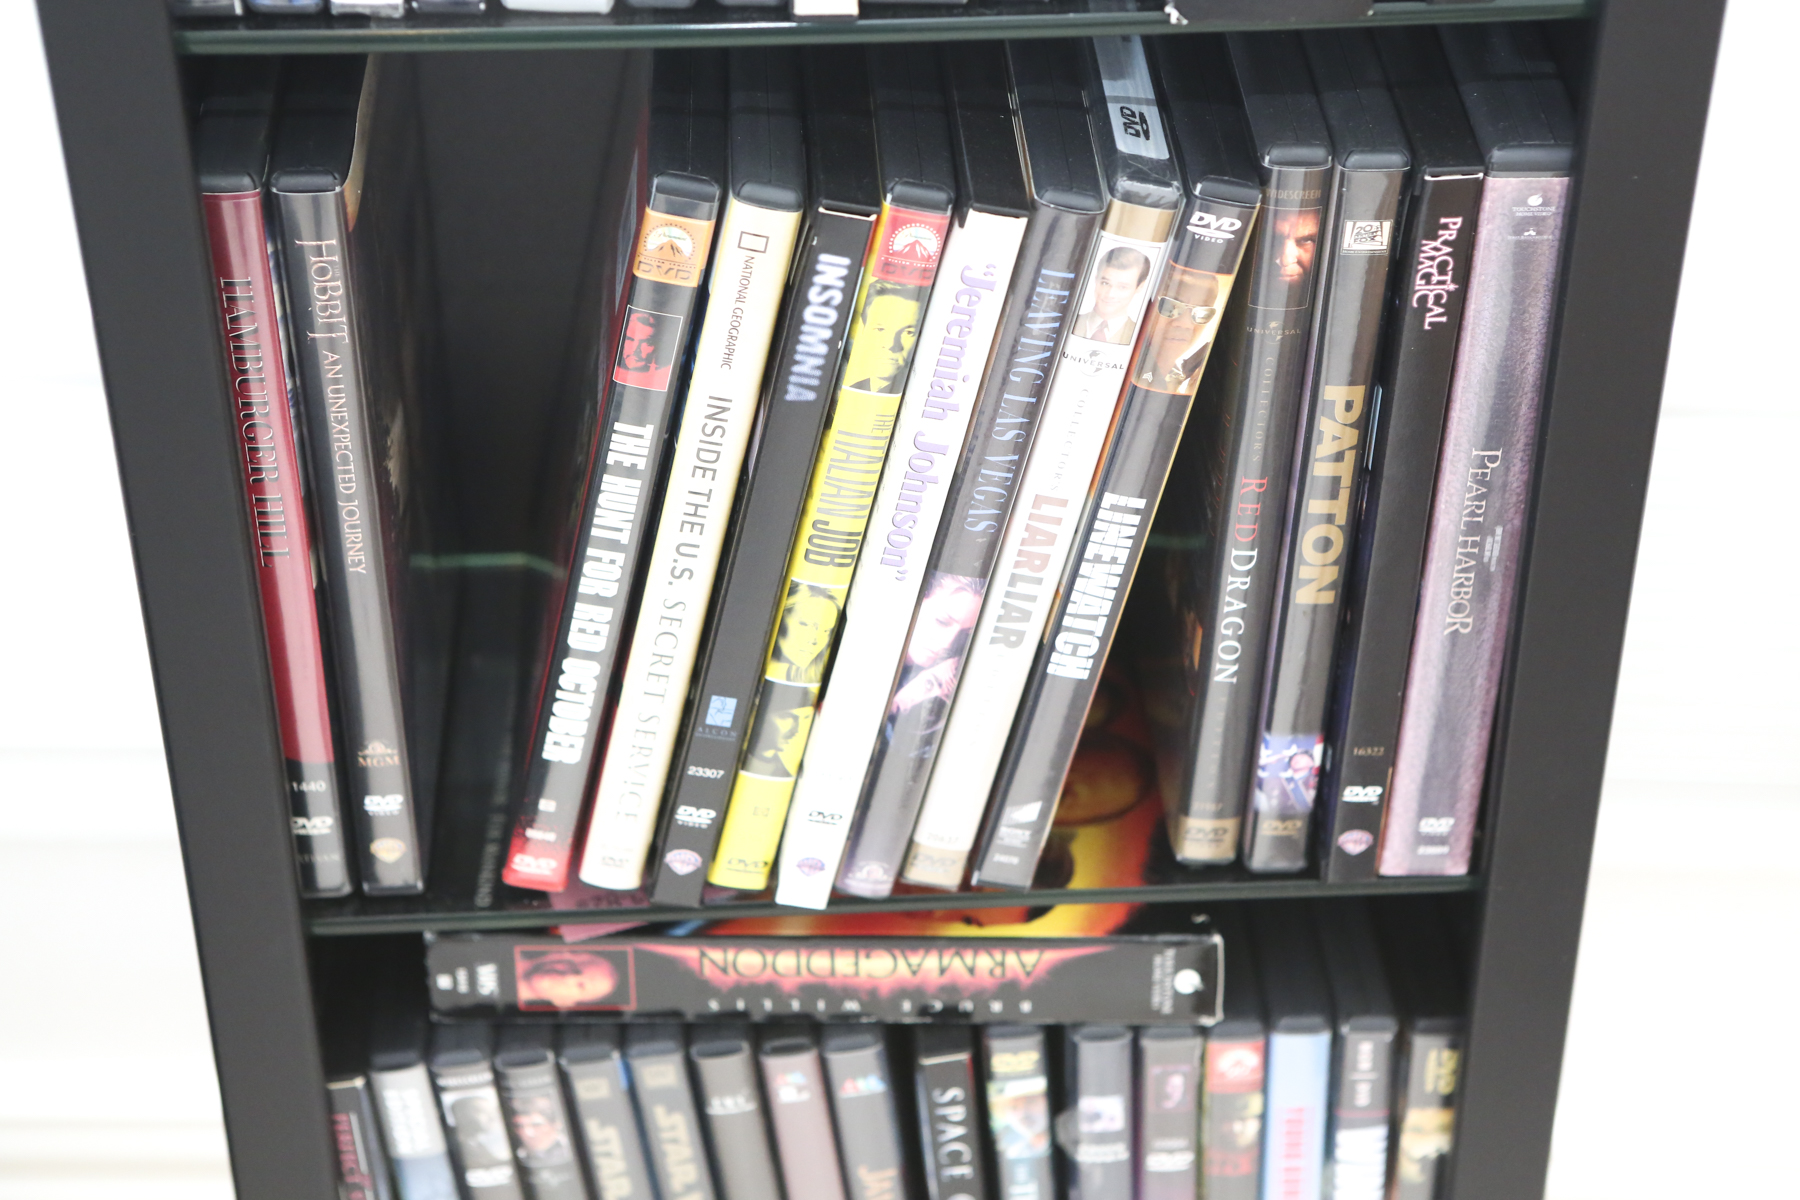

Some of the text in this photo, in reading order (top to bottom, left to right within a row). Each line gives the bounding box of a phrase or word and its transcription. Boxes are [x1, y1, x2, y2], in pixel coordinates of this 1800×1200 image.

[1119, 105, 1141, 138] DVD
[1189, 212, 1242, 232] DVD
[1267, 188, 1322, 200] WIDESCREEN
[1194, 234, 1223, 244] VIDEO
[1424, 217, 1462, 330] PRACTICAL
[720, 255, 756, 371] NATIONAL GEOGRAPHIC
[783, 253, 851, 402] INSOMNIA
[1247, 326, 1301, 337] UNIVERSAL
[1062, 352, 1125, 370] UNIVERSAL
[219, 276, 290, 568] HAMBURGER HILL
[295, 239, 367, 574] HOBBIT AN UNEXPECTED JOURNEY
[871, 414, 896, 434] THE
[962, 268, 1076, 533] LEAVING LAS VEGAS
[804, 429, 890, 568] ITALIAN JOB
[1234, 476, 1268, 542] RED
[1295, 385, 1366, 604] PATTON
[1443, 447, 1503, 637] PEARL HARBOR
[541, 421, 655, 765] THE HUNT FOR RED OCTOBER
[616, 395, 733, 823] INSIDE THE U.S. SECRET SERVICE
[1046, 494, 1146, 680] LINEWATCH
[1213, 548, 1258, 685] DRAGON
[357, 756, 400, 768] MGM
[688, 766, 725, 780] 23307
[1343, 786, 1384, 797] DVD
[677, 804, 717, 819] DVD
[808, 809, 843, 821] DVD
[727, 857, 769, 869] DVD
[697, 946, 1044, 979] ARMAGEDDON
[652, 1103, 699, 1193] STAR
[931, 1086, 975, 1183] SPACE
